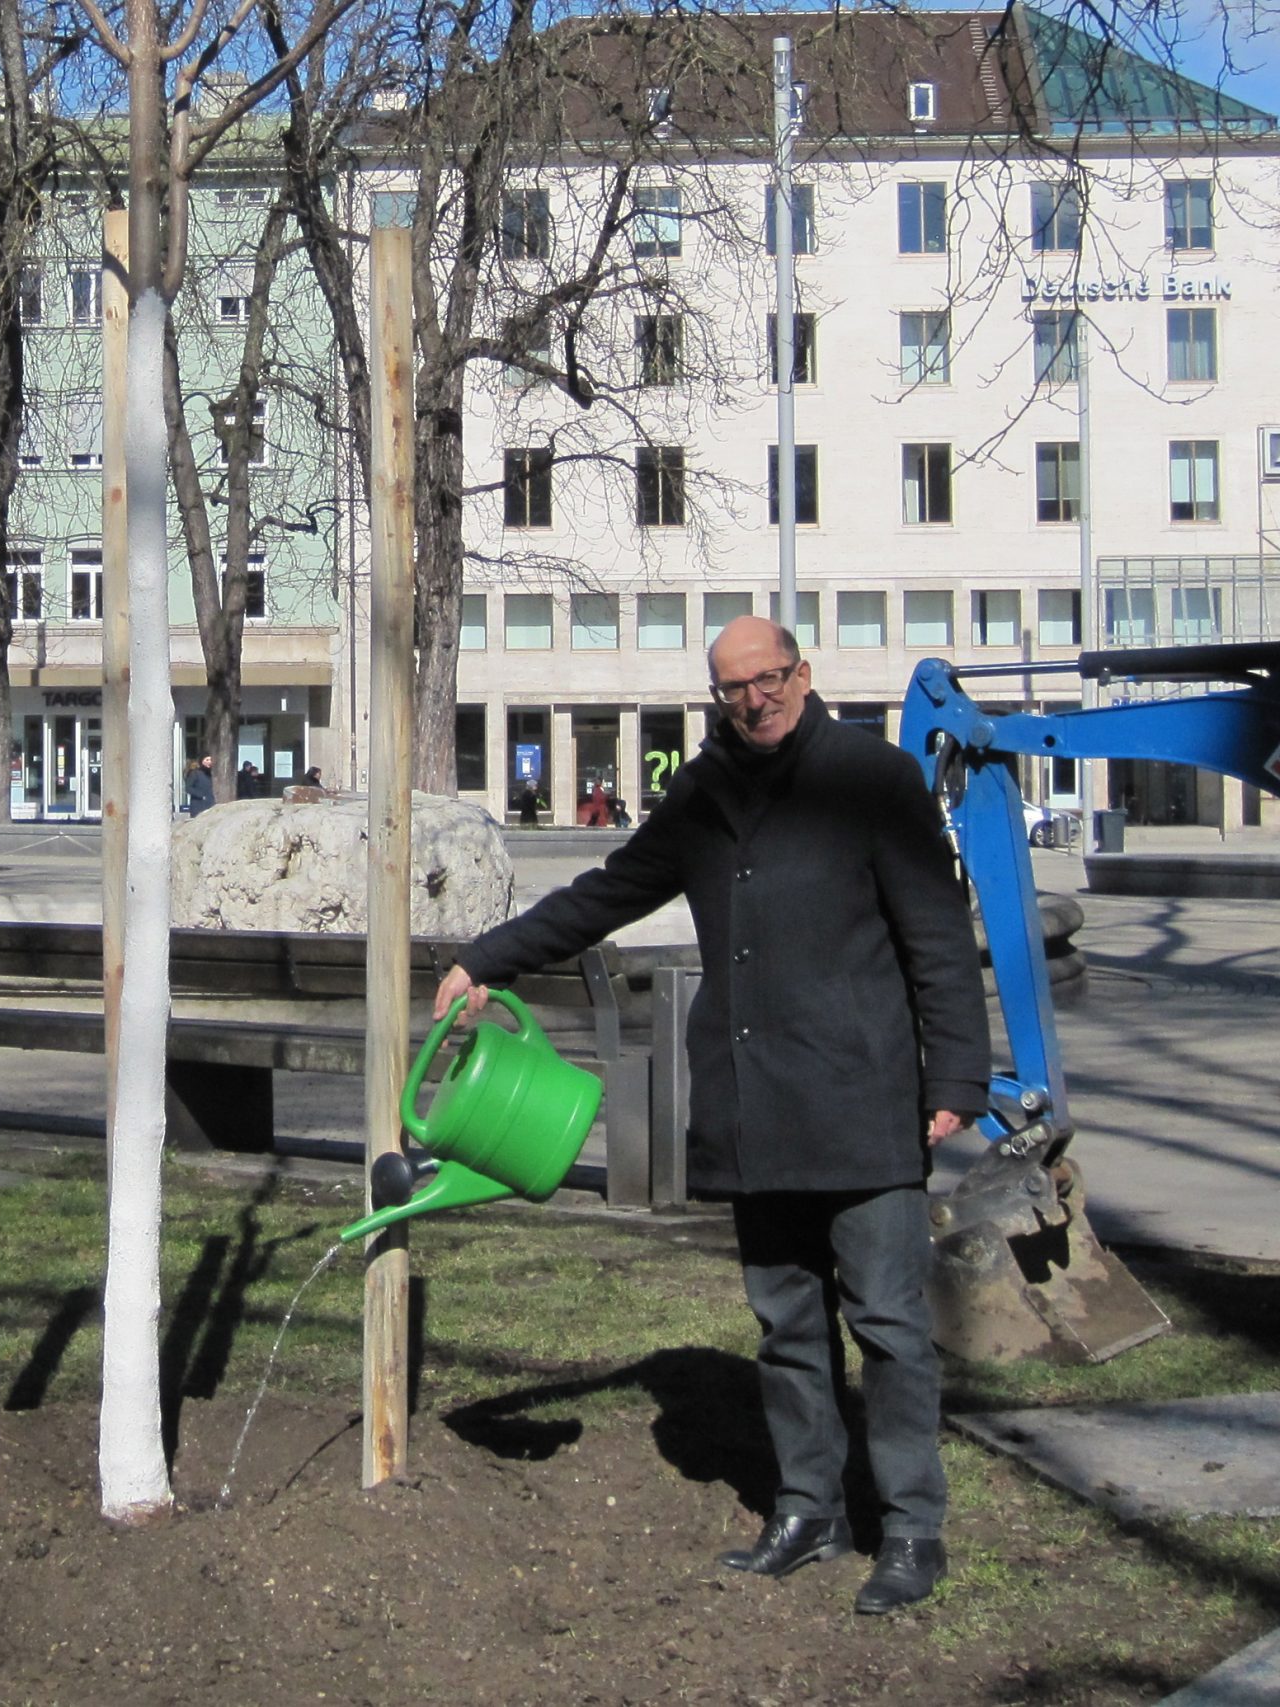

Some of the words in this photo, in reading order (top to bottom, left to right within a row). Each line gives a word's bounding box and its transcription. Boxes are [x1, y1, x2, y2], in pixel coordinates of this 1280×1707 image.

[1021, 275, 1150, 301] Deutsche
[1163, 275, 1231, 301] Bank
[41, 691, 102, 706] TARGO
